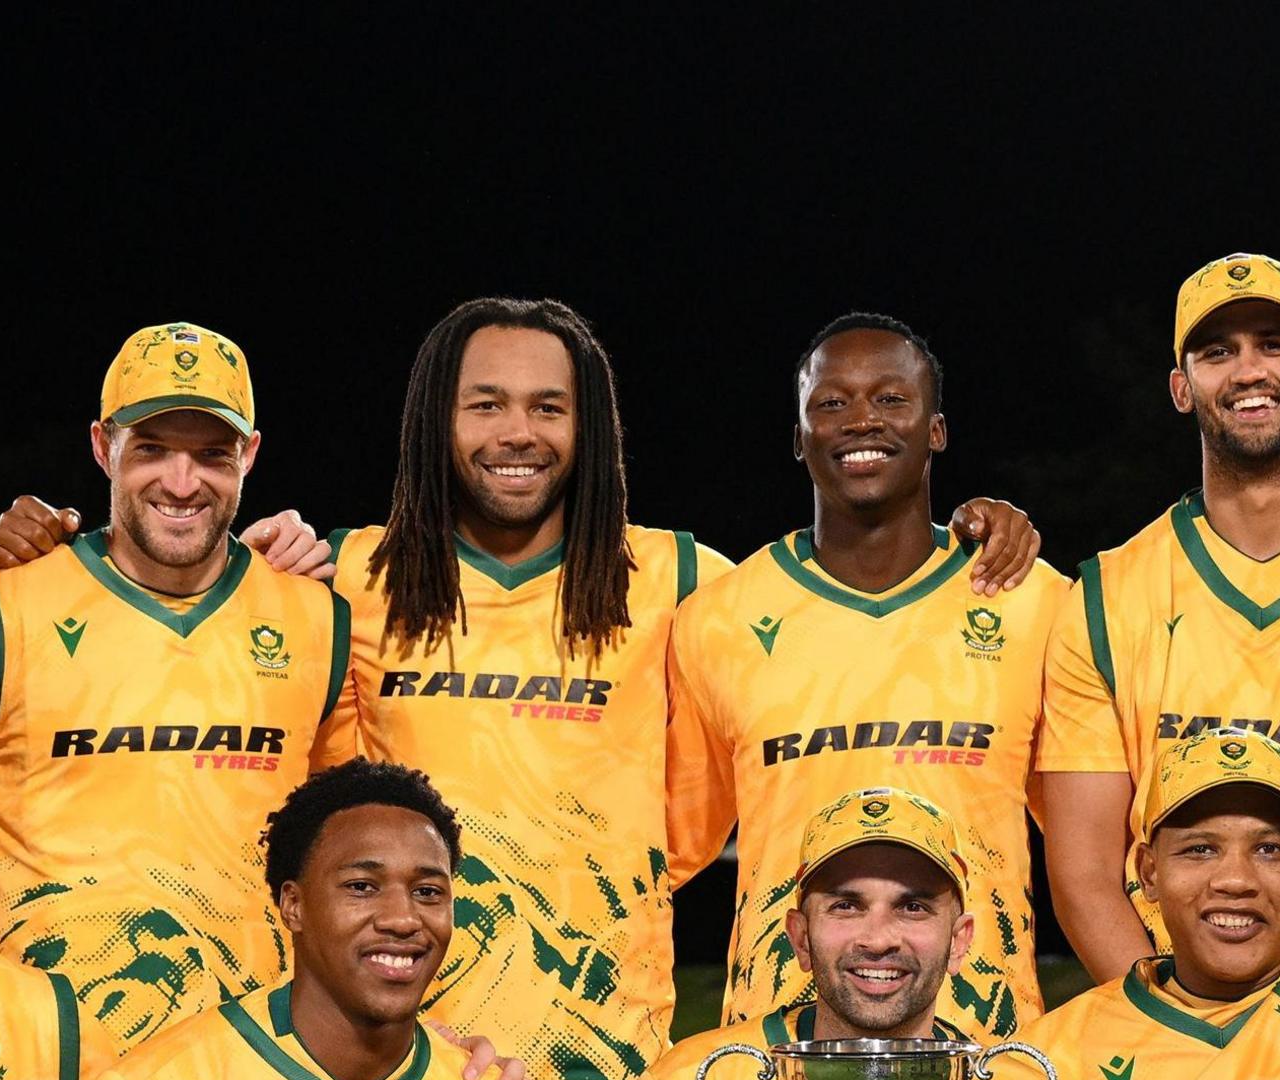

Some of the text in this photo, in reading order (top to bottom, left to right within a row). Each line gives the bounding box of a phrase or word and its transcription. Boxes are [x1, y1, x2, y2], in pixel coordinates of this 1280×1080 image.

[965, 651, 1001, 662] PROTEAS
[379, 671, 612, 706] RADAR
[510, 703, 604, 723] TYRES
[51, 725, 286, 759] RADAR
[762, 720, 995, 767] RADAR
[192, 754, 280, 772] TYRES
[892, 750, 986, 767] TYRES
